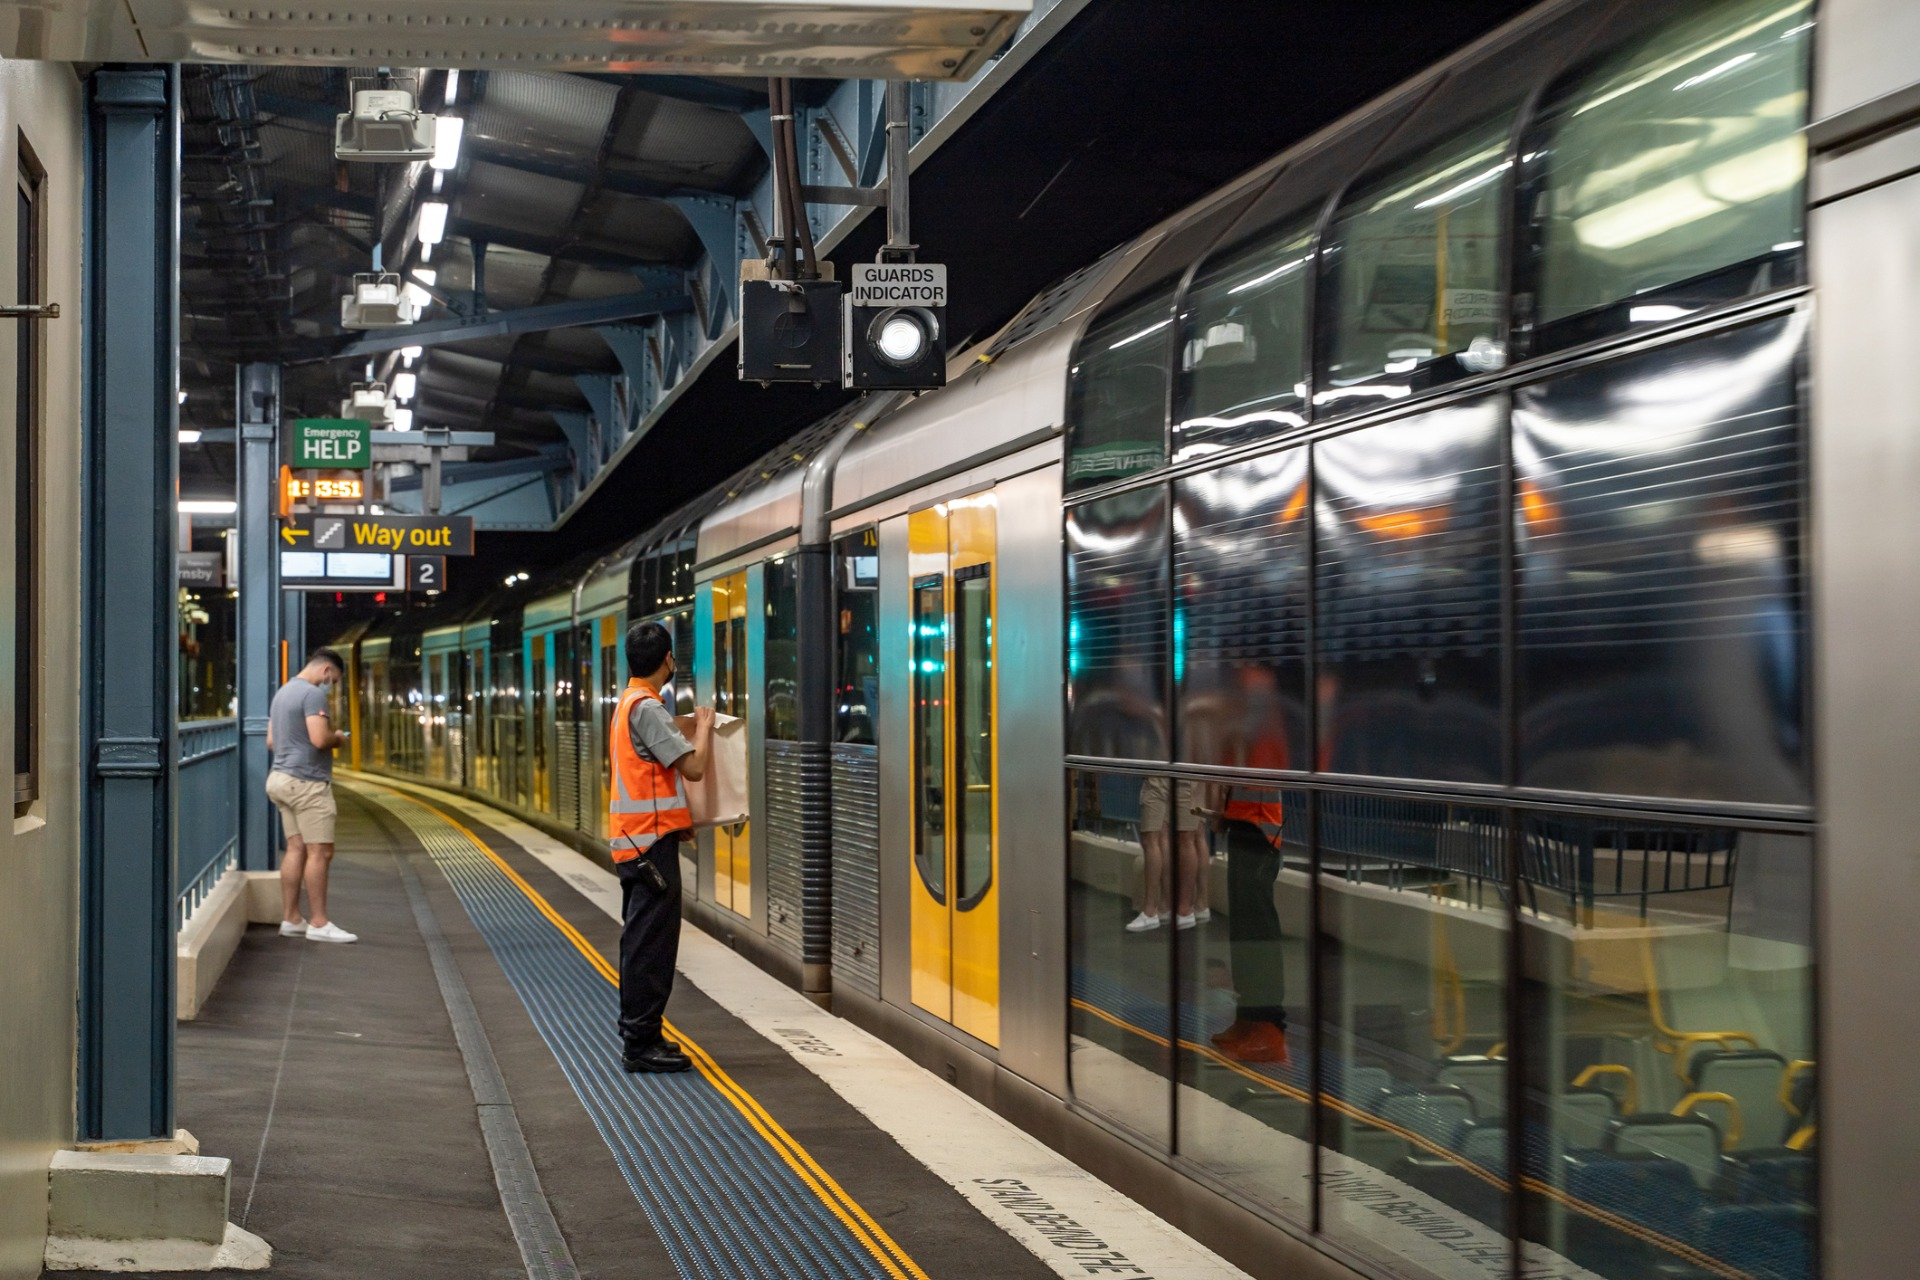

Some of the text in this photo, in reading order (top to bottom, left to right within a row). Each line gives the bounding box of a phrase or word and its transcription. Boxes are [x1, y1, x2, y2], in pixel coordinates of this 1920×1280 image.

[865, 268, 934, 283] GUARDS
[855, 286, 944, 300] INDICATOR
[304, 427, 361, 439] Emergency
[304, 439, 361, 459] HELP
[353, 523, 452, 550] Way out
[419, 563, 434, 583] 2
[972, 1178, 1146, 1274] STAND BEHIND THE
